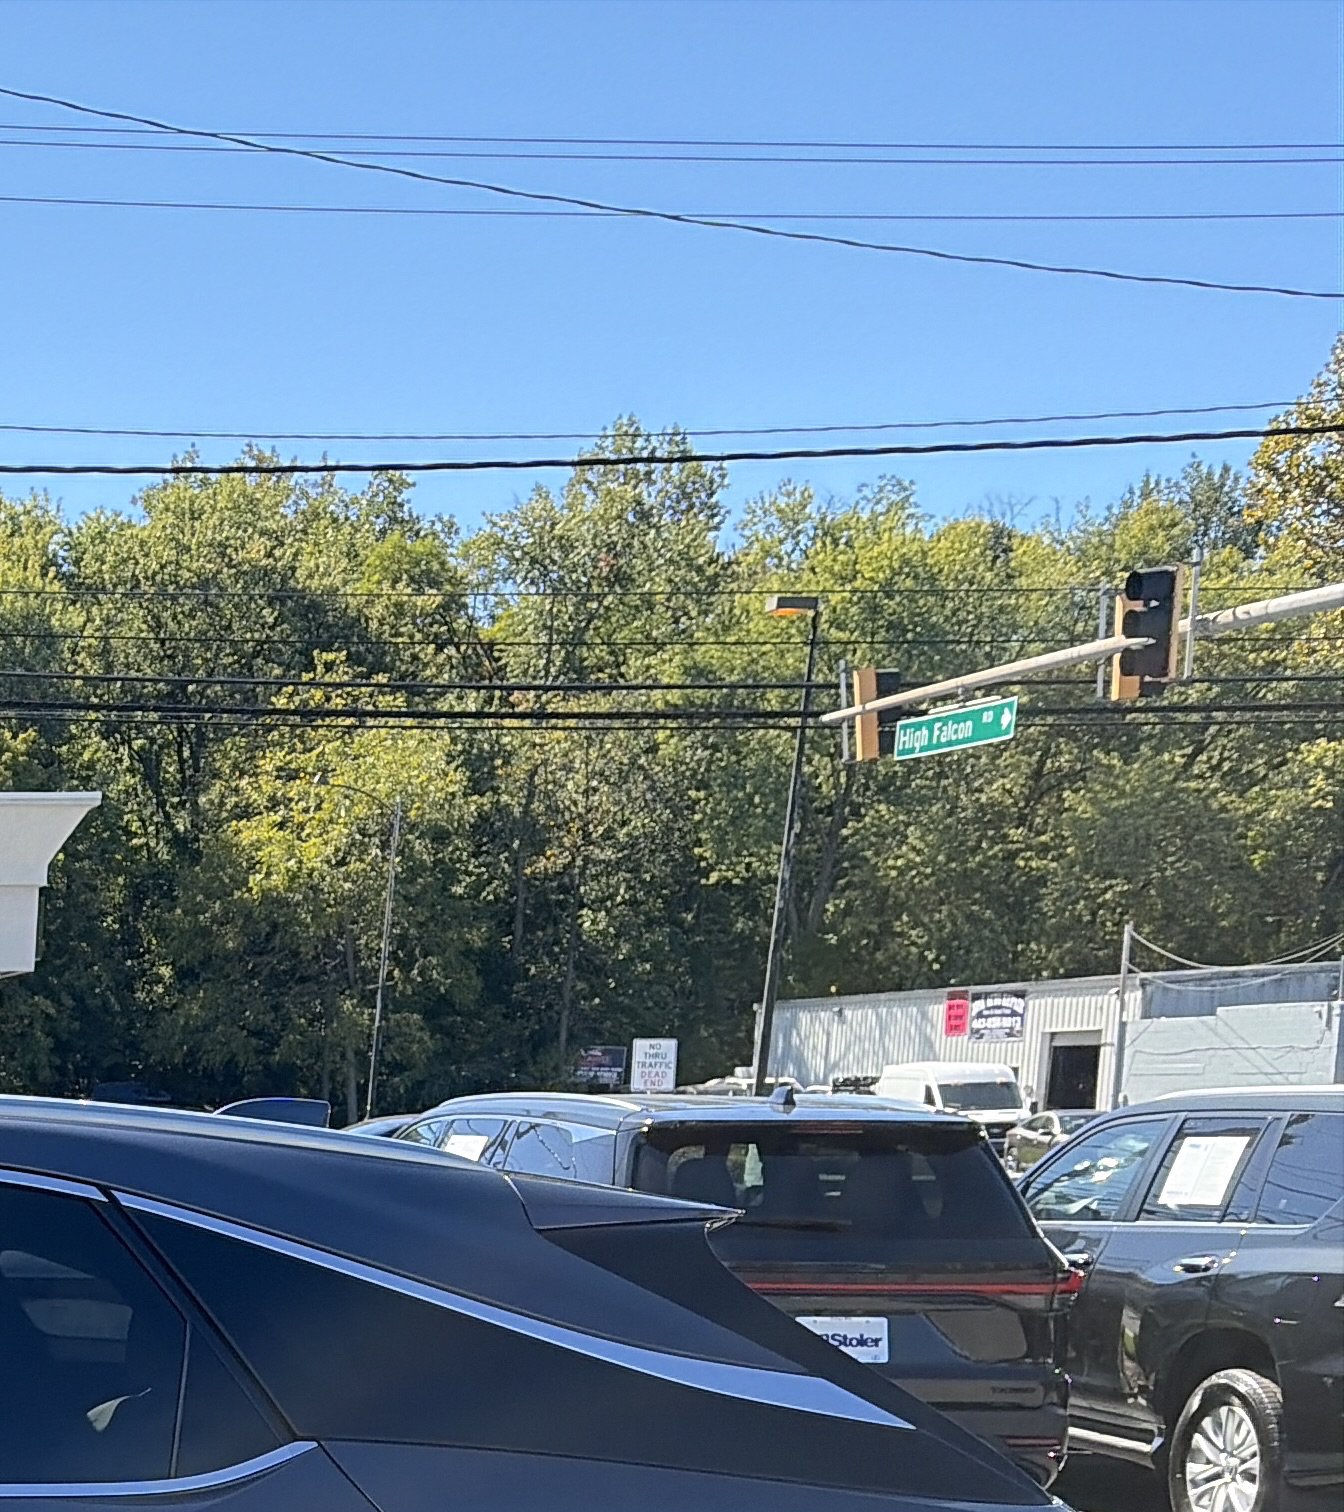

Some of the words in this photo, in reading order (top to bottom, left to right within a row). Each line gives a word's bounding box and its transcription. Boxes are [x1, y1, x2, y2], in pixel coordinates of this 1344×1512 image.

[899, 726, 929, 754] High
[932, 720, 973, 745] Falcon
[648, 1043, 662, 1051] NO
[644, 1052, 668, 1060] THRU
[636, 1060, 673, 1070] TRAFFIC
[640, 1070, 668, 1079] DEAD
[643, 1079, 664, 1087] END
